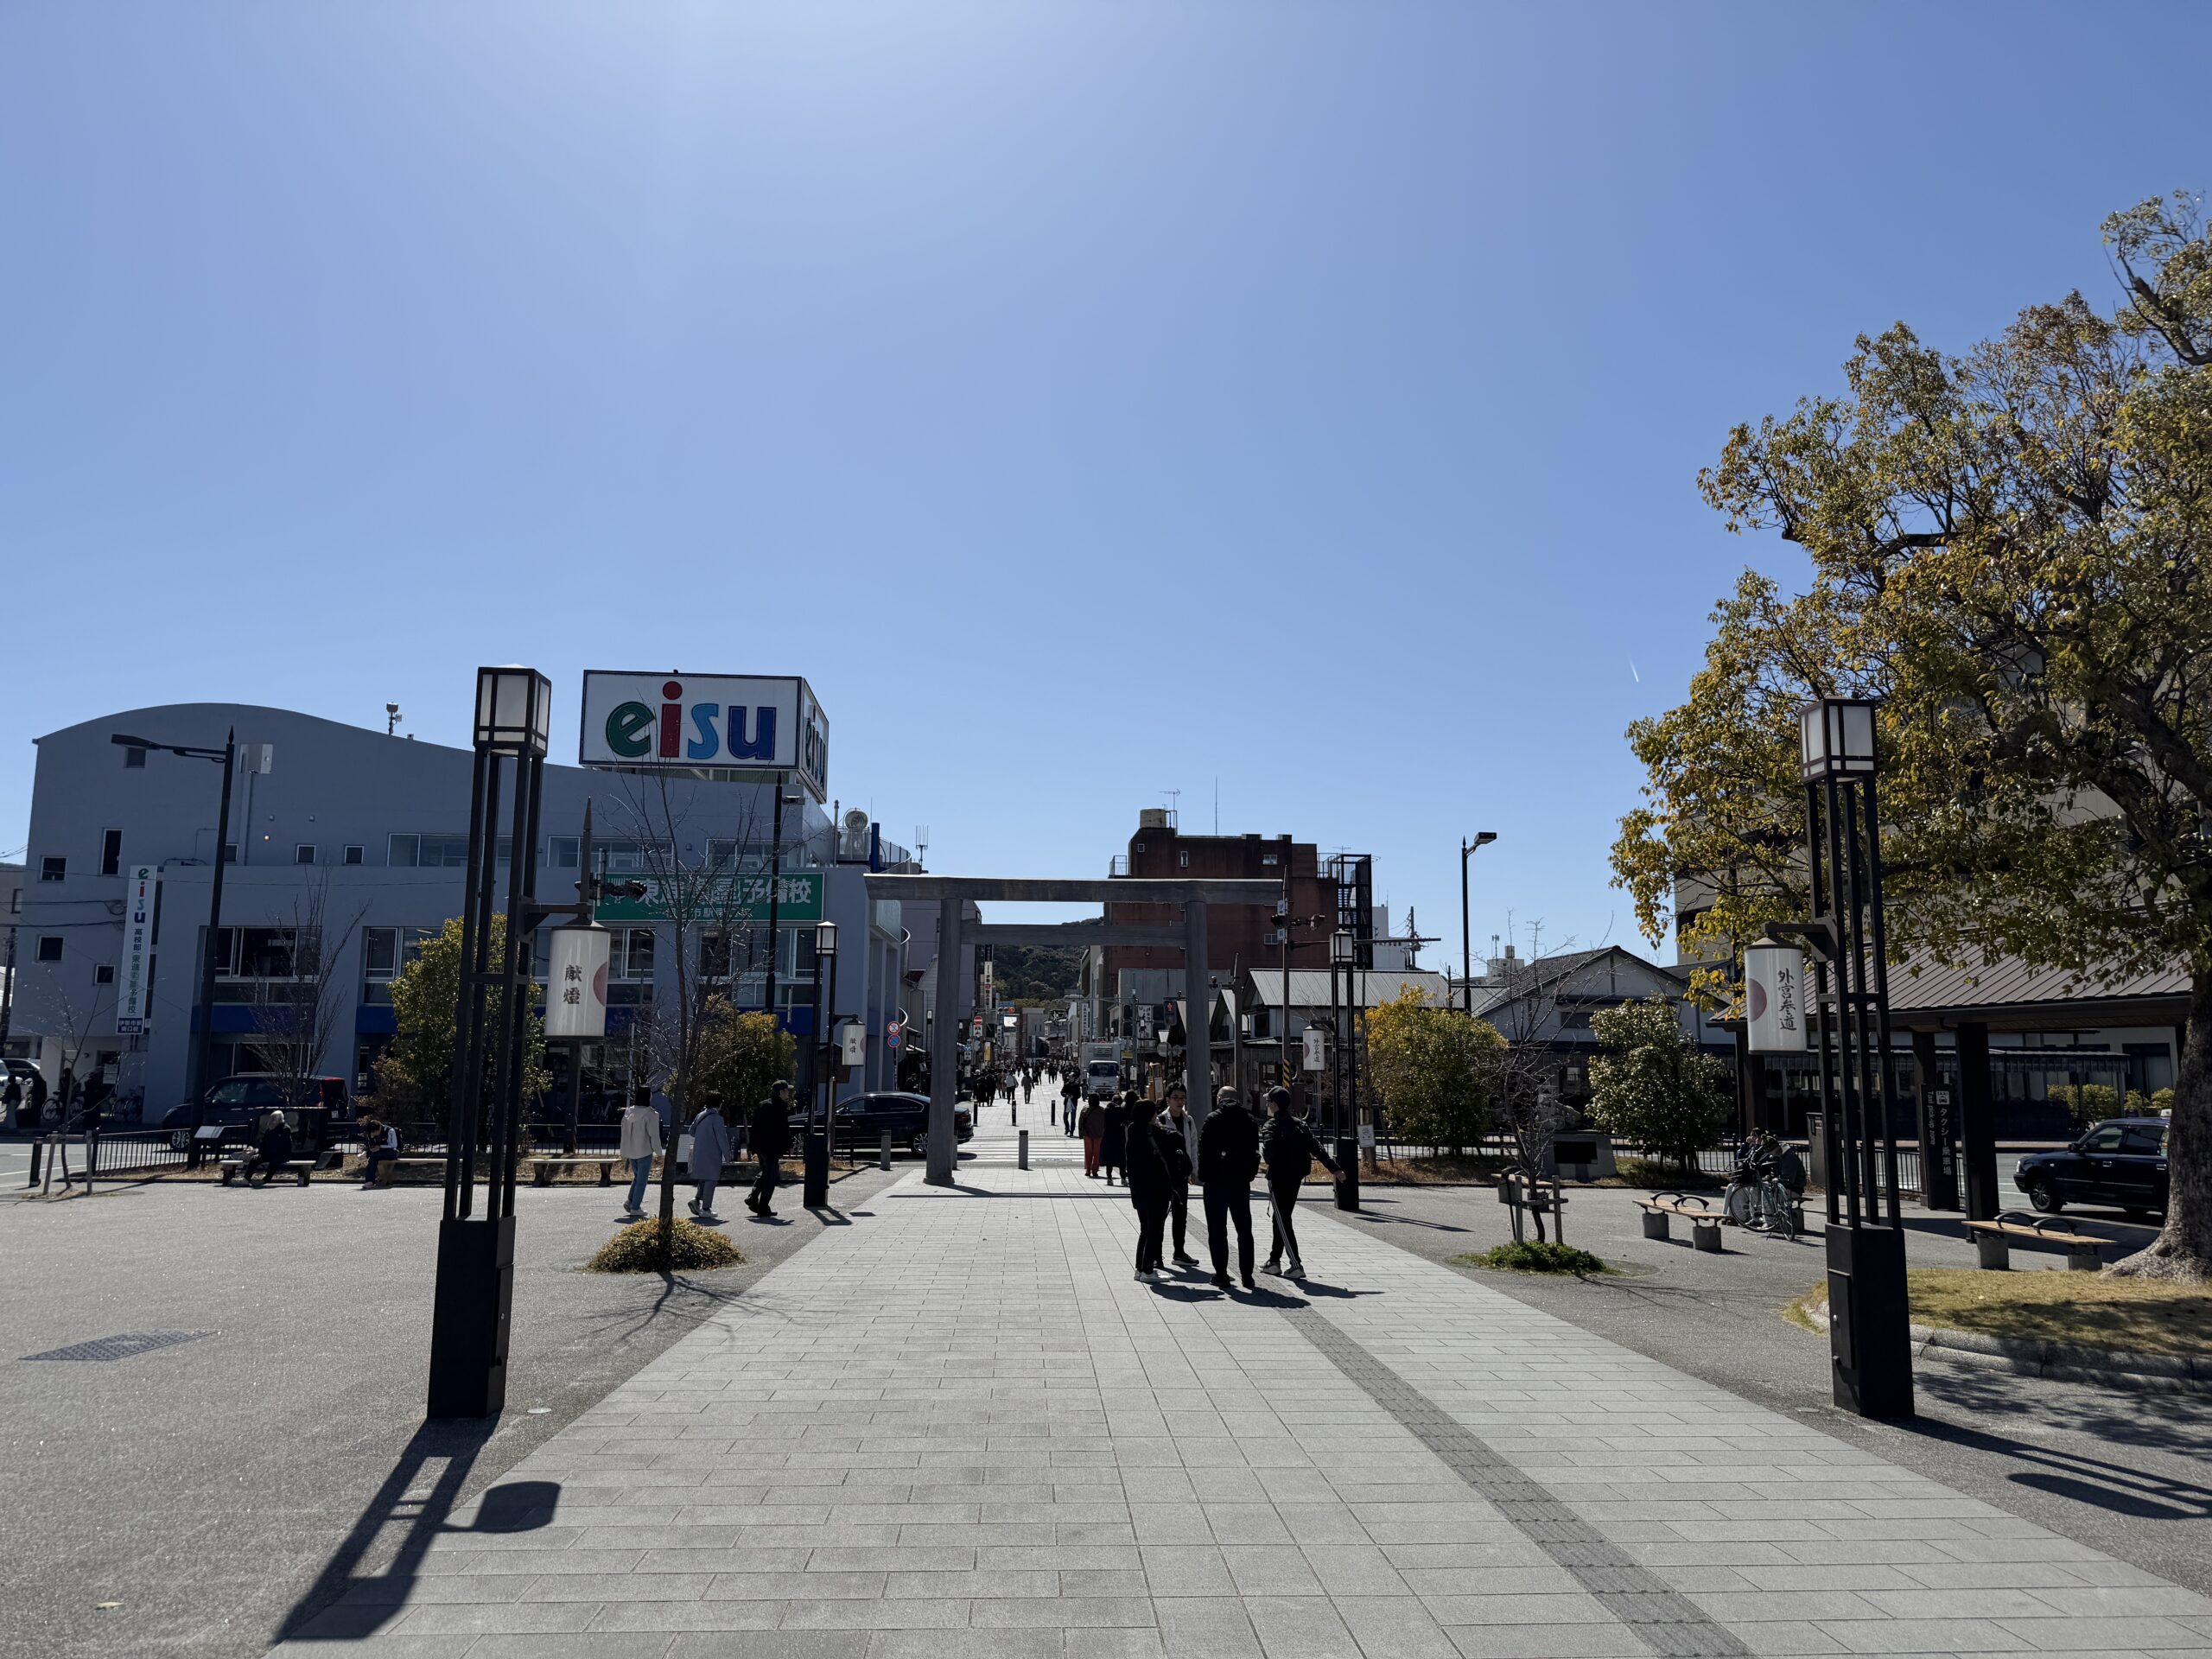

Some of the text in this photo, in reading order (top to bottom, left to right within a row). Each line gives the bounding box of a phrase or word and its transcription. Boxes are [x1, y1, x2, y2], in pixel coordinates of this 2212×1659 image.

[605, 681, 777, 760] eisu
[134, 868, 149, 924] eisu
[563, 964, 582, 1005] 献燈
[1777, 968, 1797, 1031] 外宮参道
